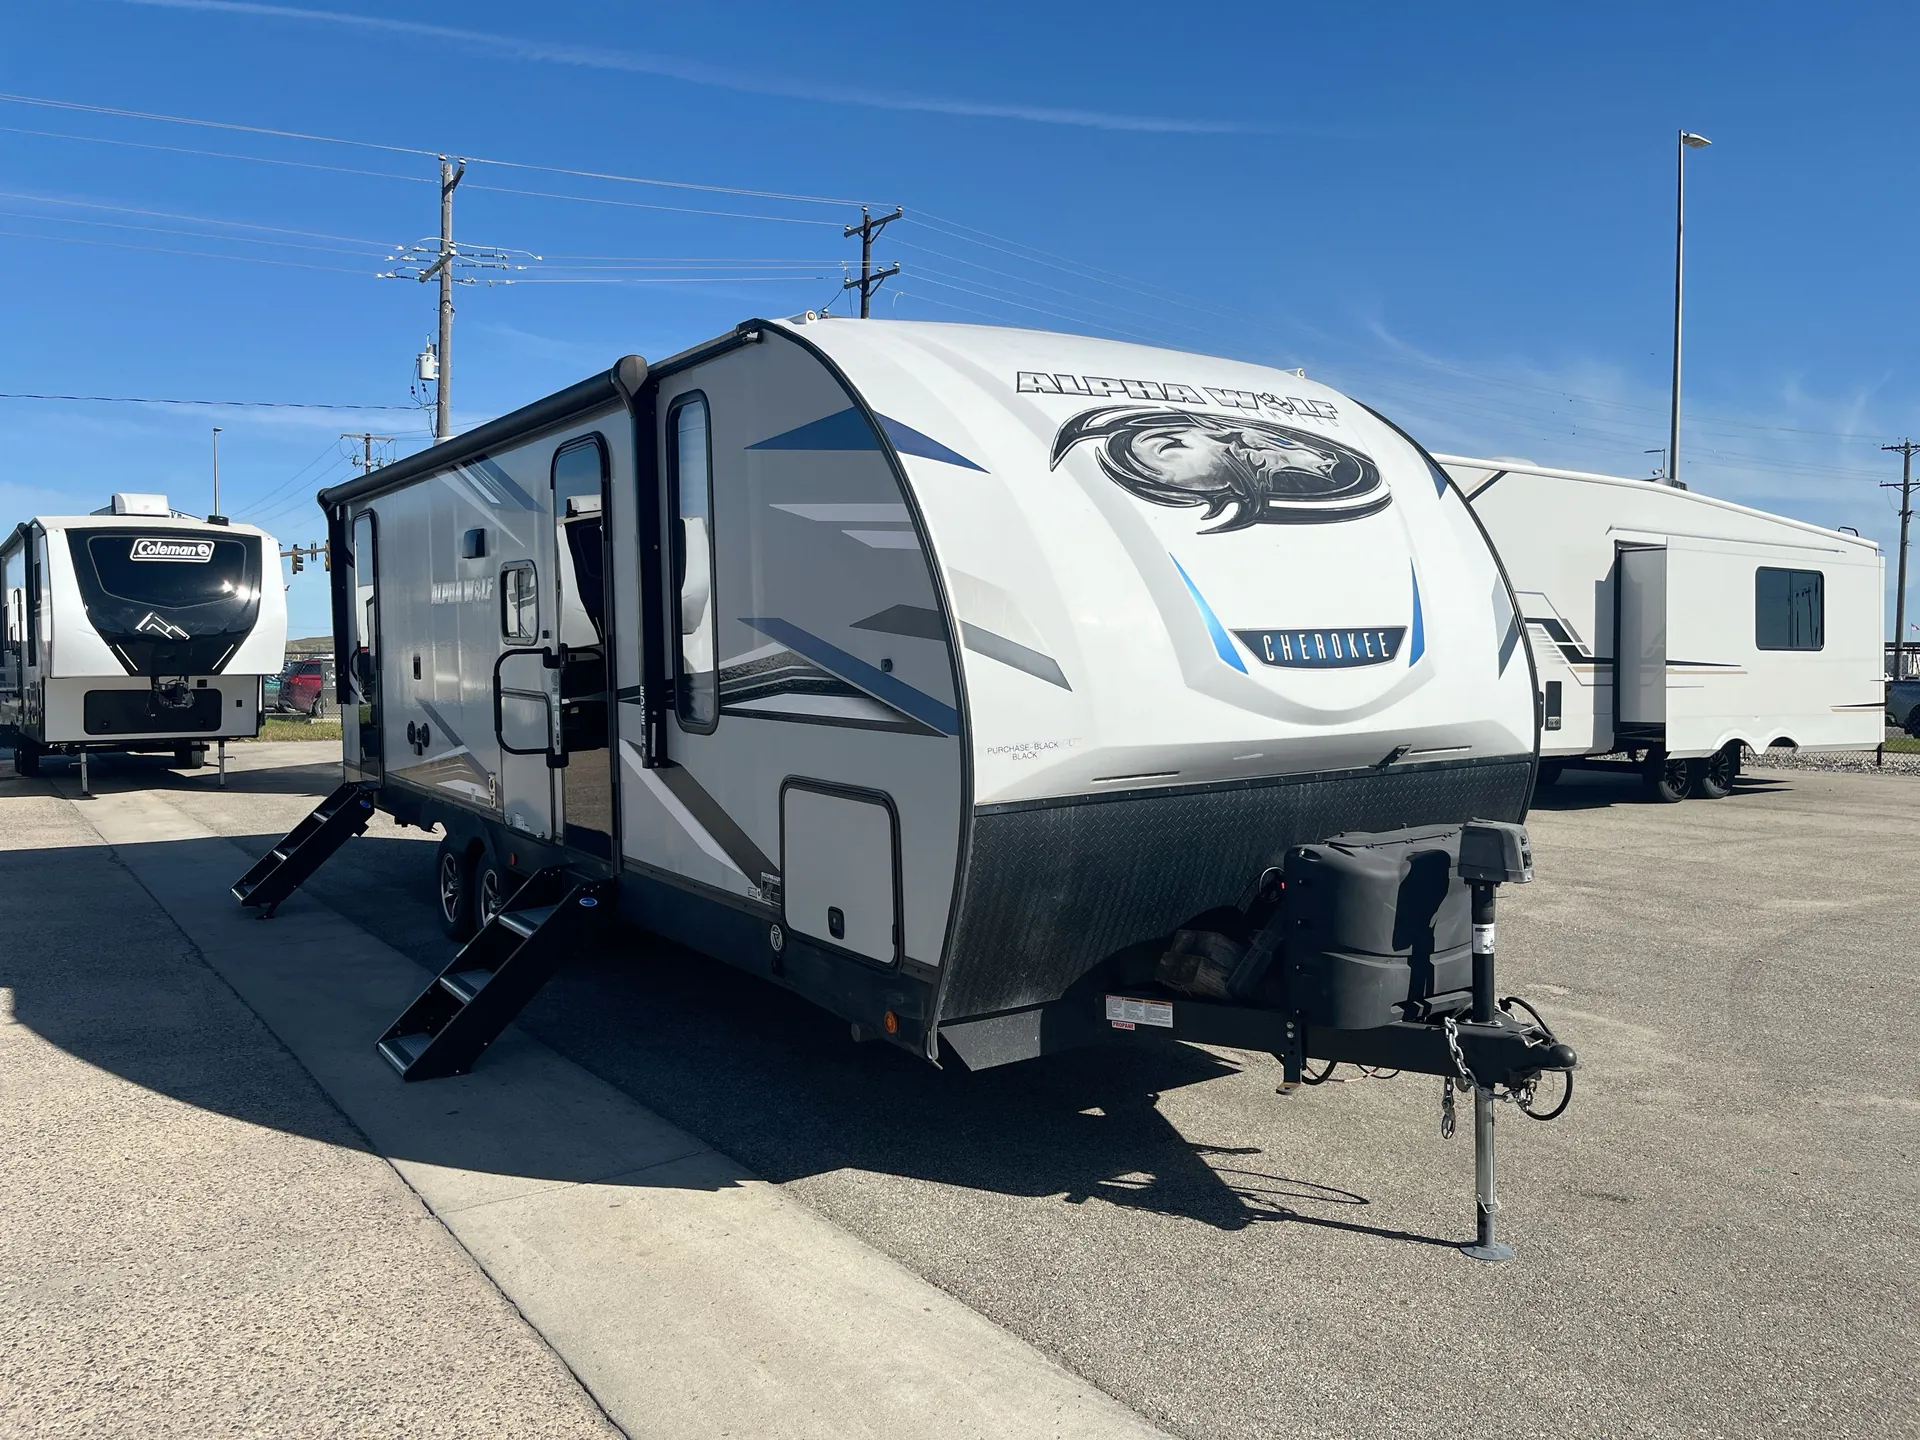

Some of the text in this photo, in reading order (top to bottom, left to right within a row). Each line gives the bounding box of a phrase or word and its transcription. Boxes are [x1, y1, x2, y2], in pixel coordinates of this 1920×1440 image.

[1016, 371, 1206, 405] ALPHA
[138, 541, 197, 556] Coleman
[1262, 632, 1390, 662] CHEROKEE
[1012, 751, 1038, 761] BLACK
